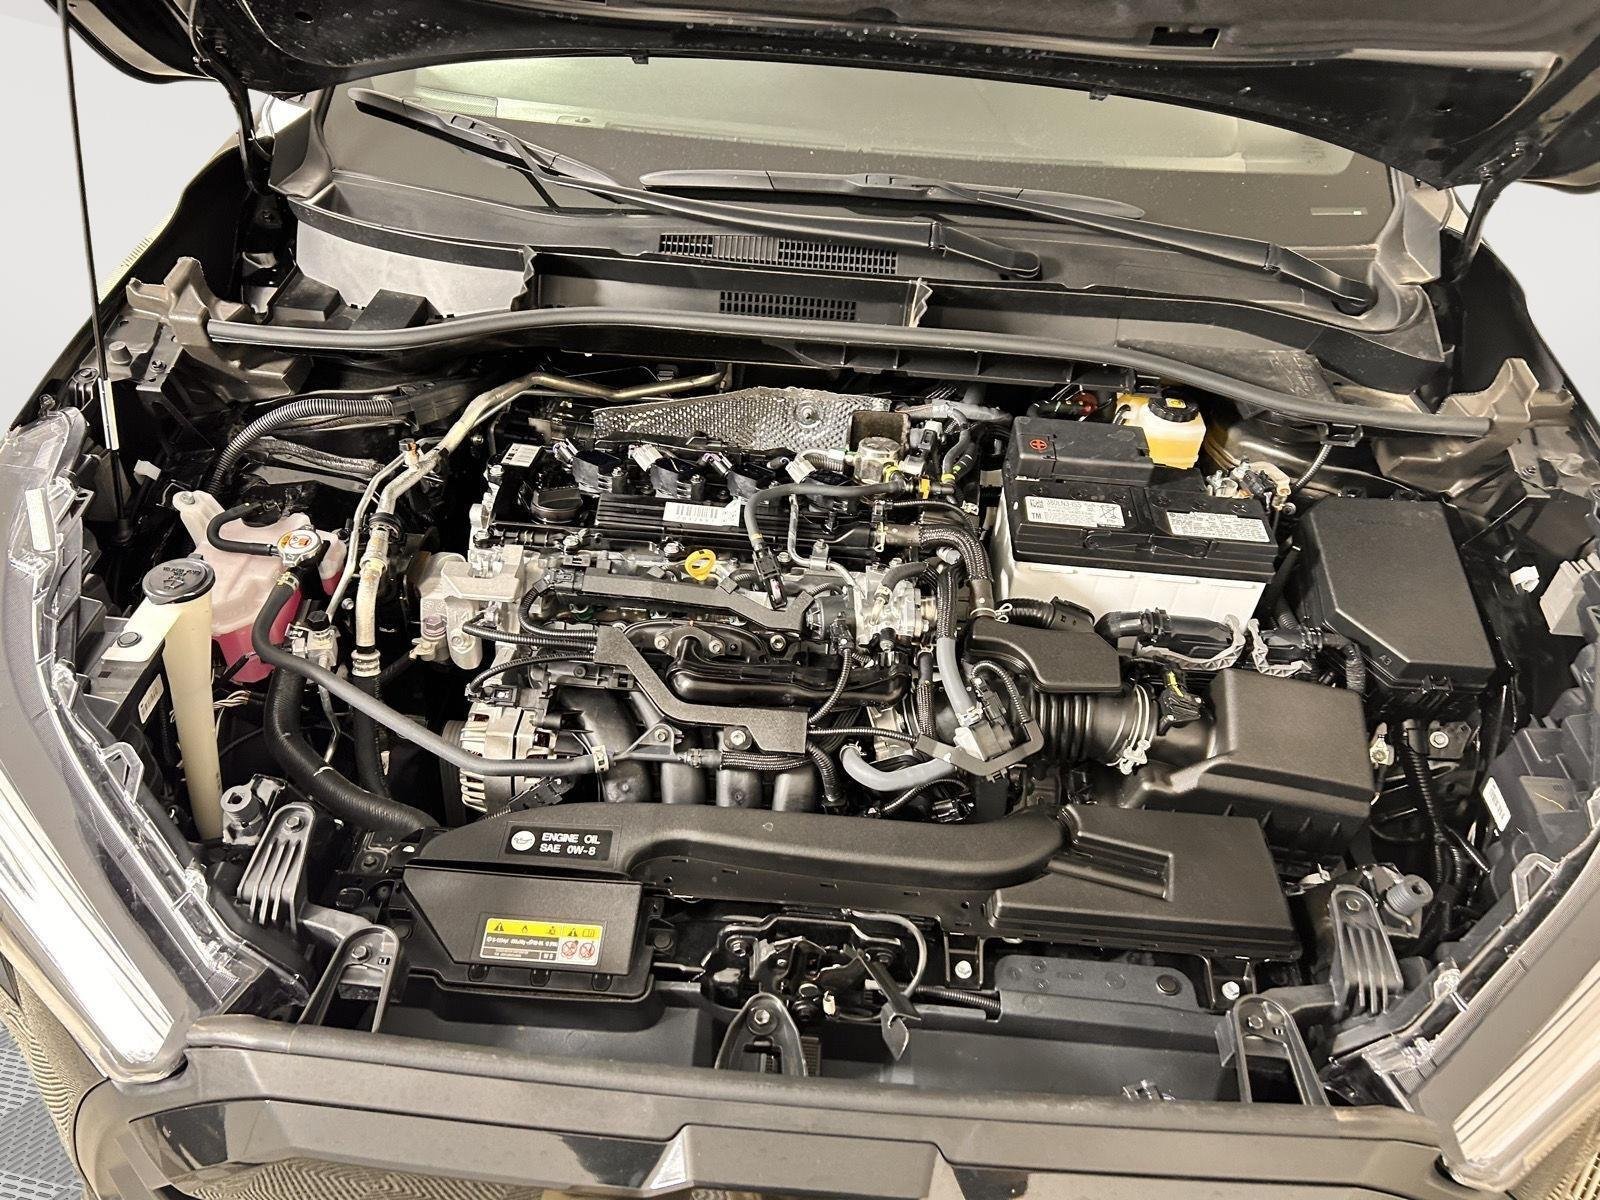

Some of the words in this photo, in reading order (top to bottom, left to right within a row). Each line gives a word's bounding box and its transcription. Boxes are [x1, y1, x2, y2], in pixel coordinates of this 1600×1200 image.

[541, 832, 579, 843] ENGINE
[584, 834, 601, 844] OIL
[539, 843, 561, 853] SAE
[567, 845, 596, 855] 0W-8
